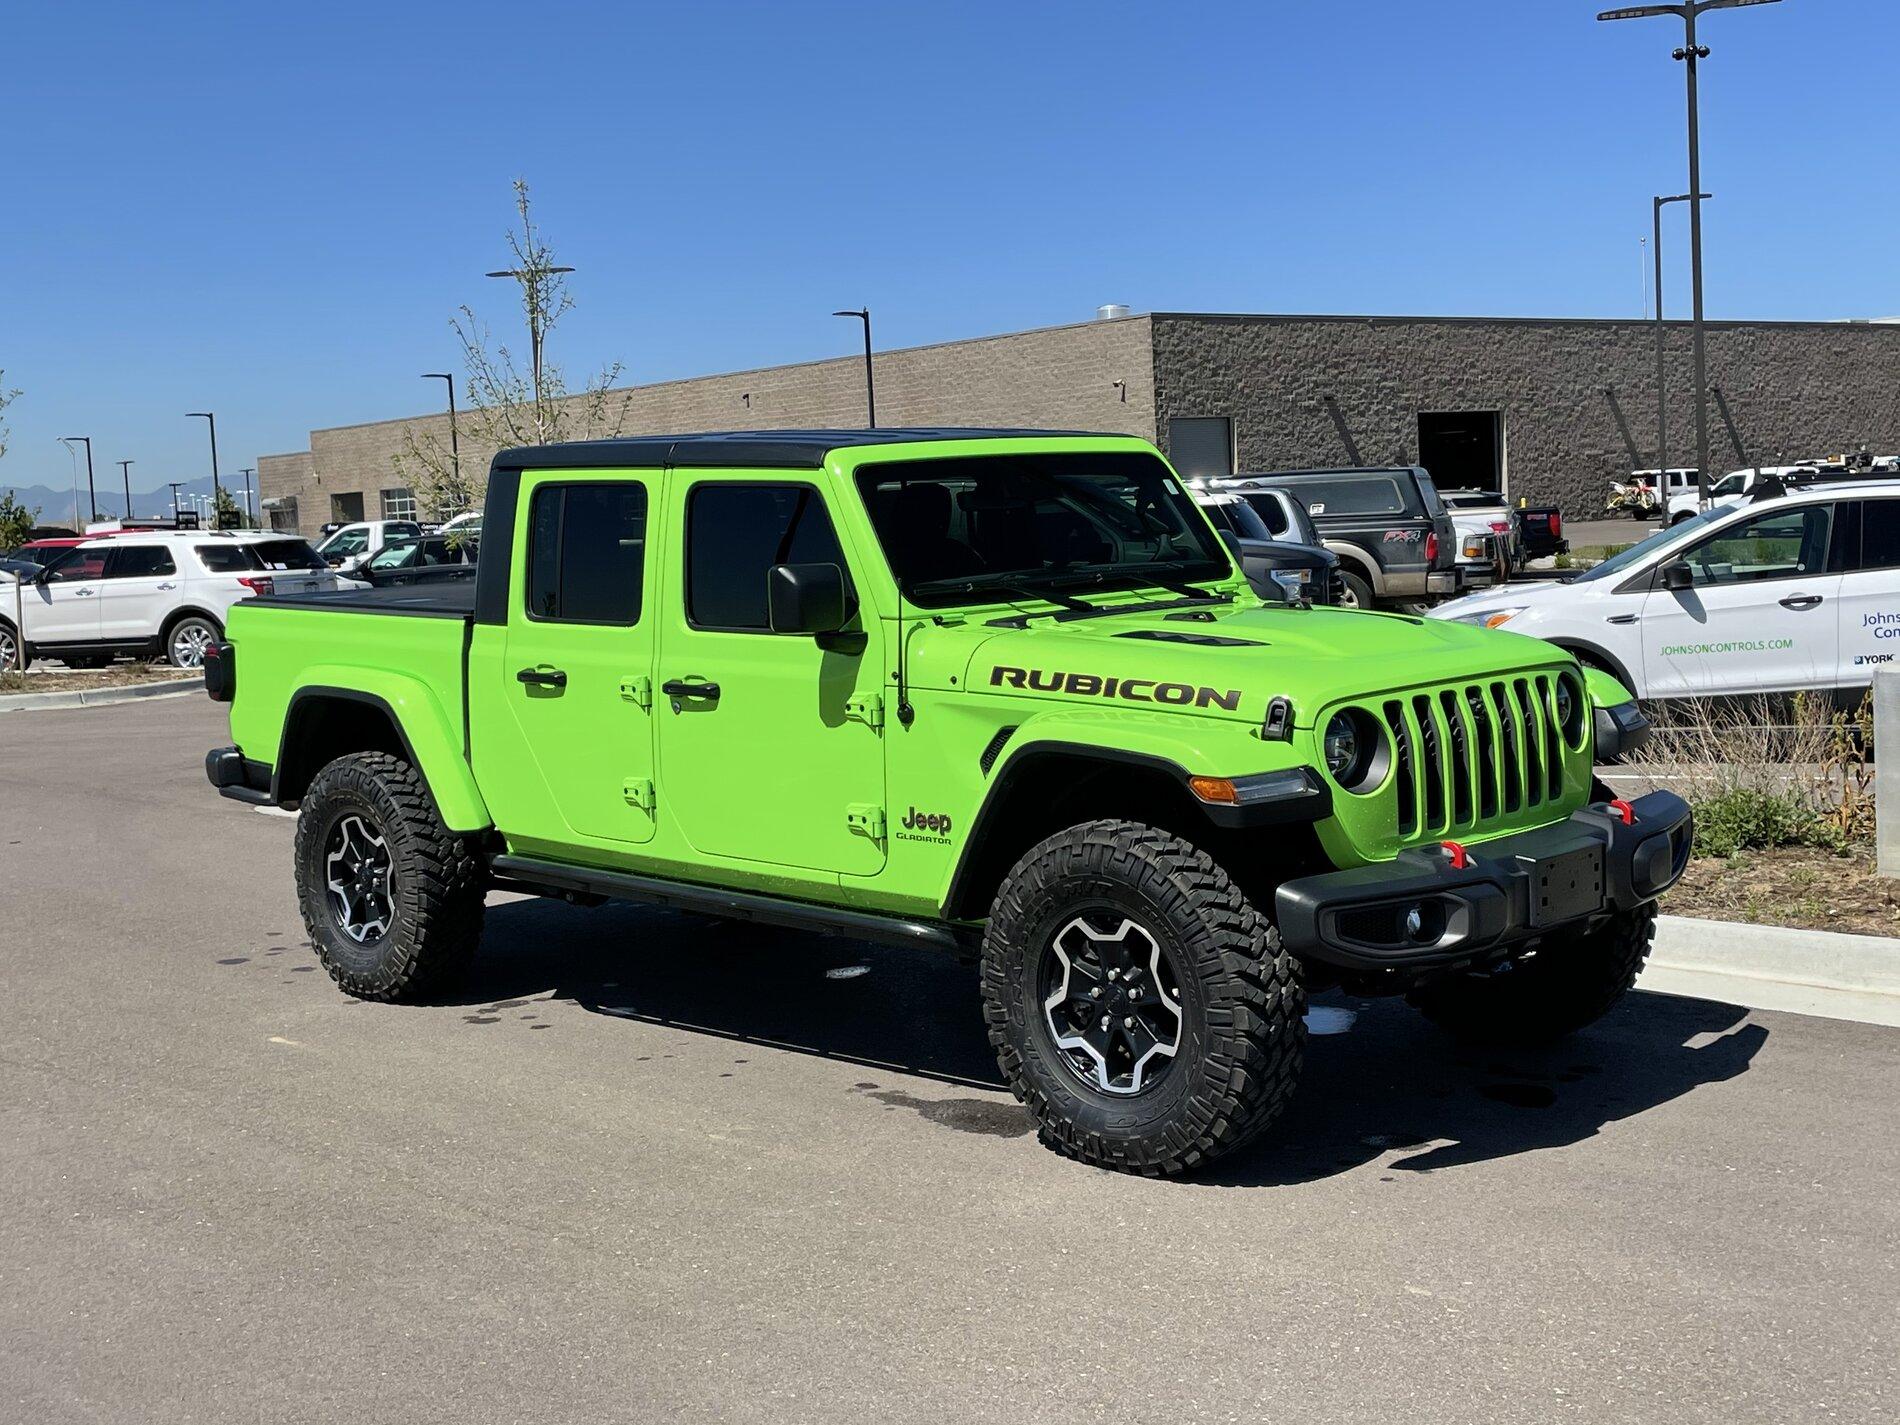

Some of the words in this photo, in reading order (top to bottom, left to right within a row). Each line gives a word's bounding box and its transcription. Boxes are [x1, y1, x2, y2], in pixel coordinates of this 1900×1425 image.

[1383, 530, 1421, 543] FX4
[1660, 639, 1793, 656] JOHNSONCONTROLS.COM
[1864, 654, 1895, 665] YORK
[989, 665, 1242, 711] RUBICON
[901, 806, 952, 834] Jeep
[896, 832, 952, 846] GLADIATOR
